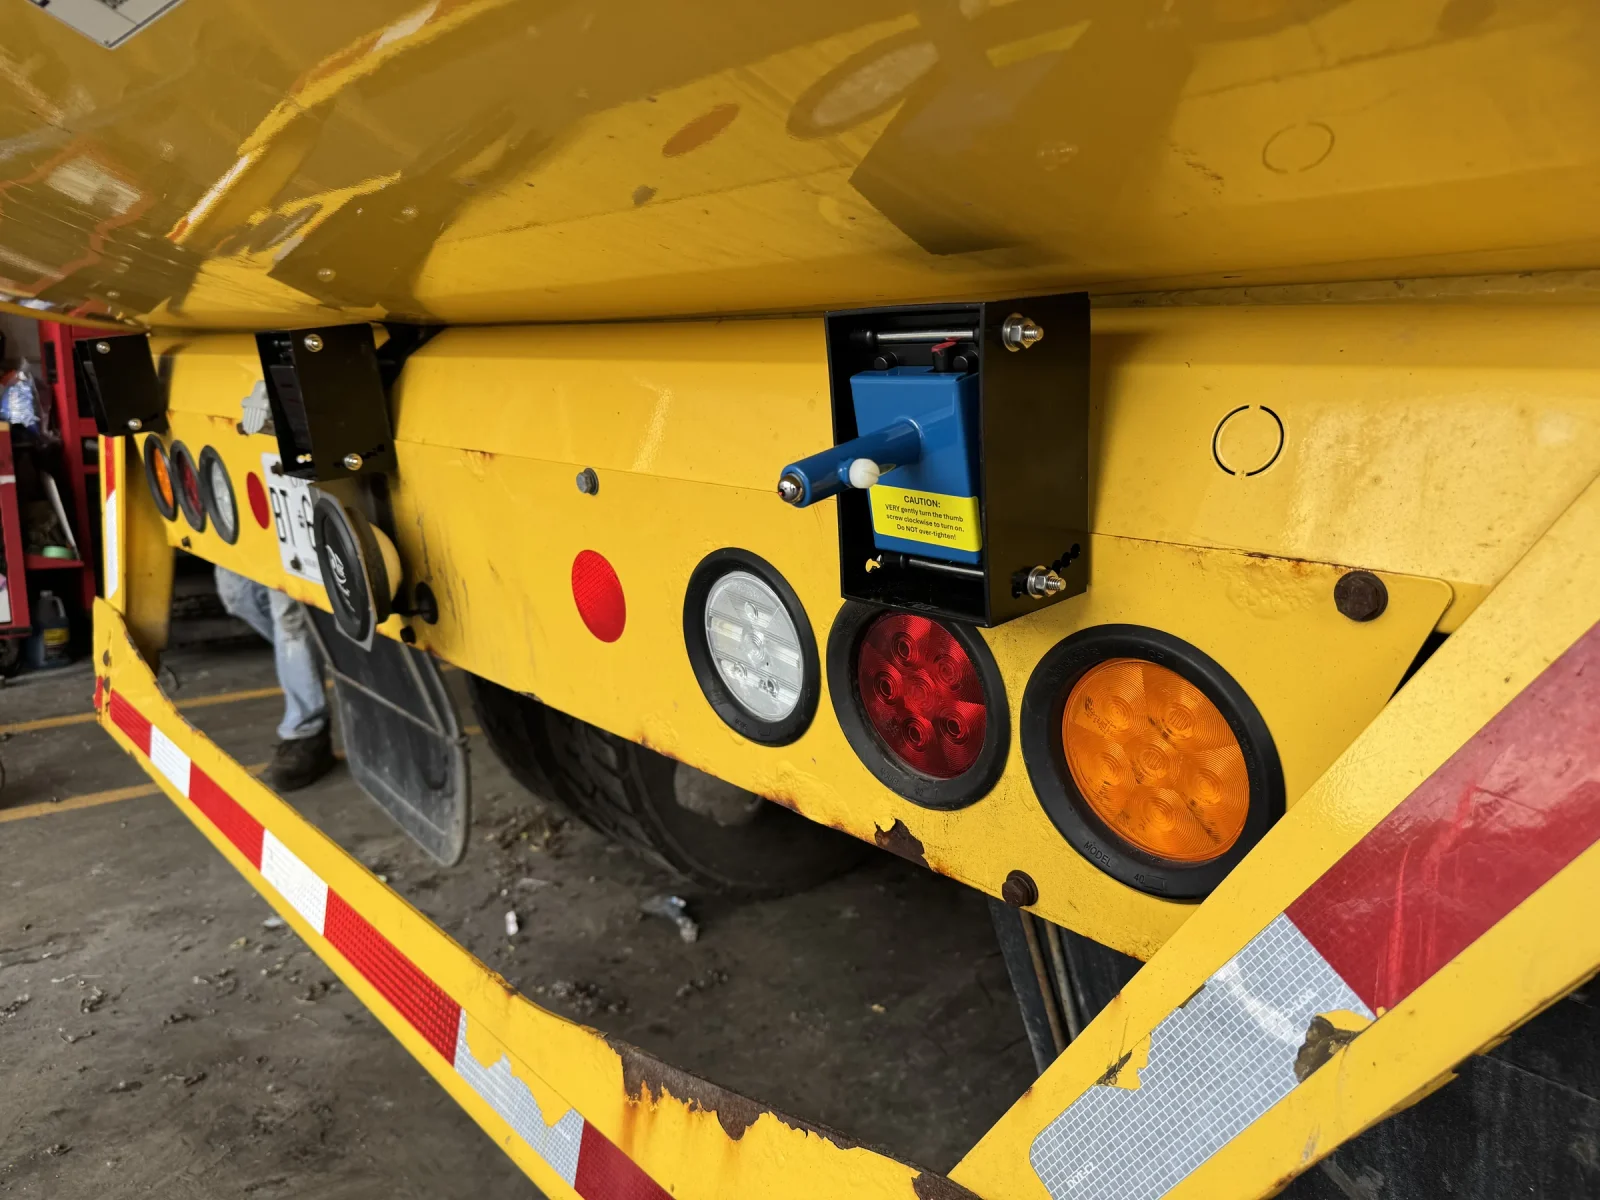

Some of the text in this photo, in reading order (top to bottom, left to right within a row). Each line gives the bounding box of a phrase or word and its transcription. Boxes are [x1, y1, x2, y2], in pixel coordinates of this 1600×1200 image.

[904, 496, 940, 507] CAUTION:
[885, 504, 900, 512] VERY
[901, 507, 918, 515] gently
[944, 513, 963, 522] thumb
[904, 516, 932, 526] clockwise
[919, 528, 956, 540] over-tighten!
[1083, 840, 1112, 868] MODEL
